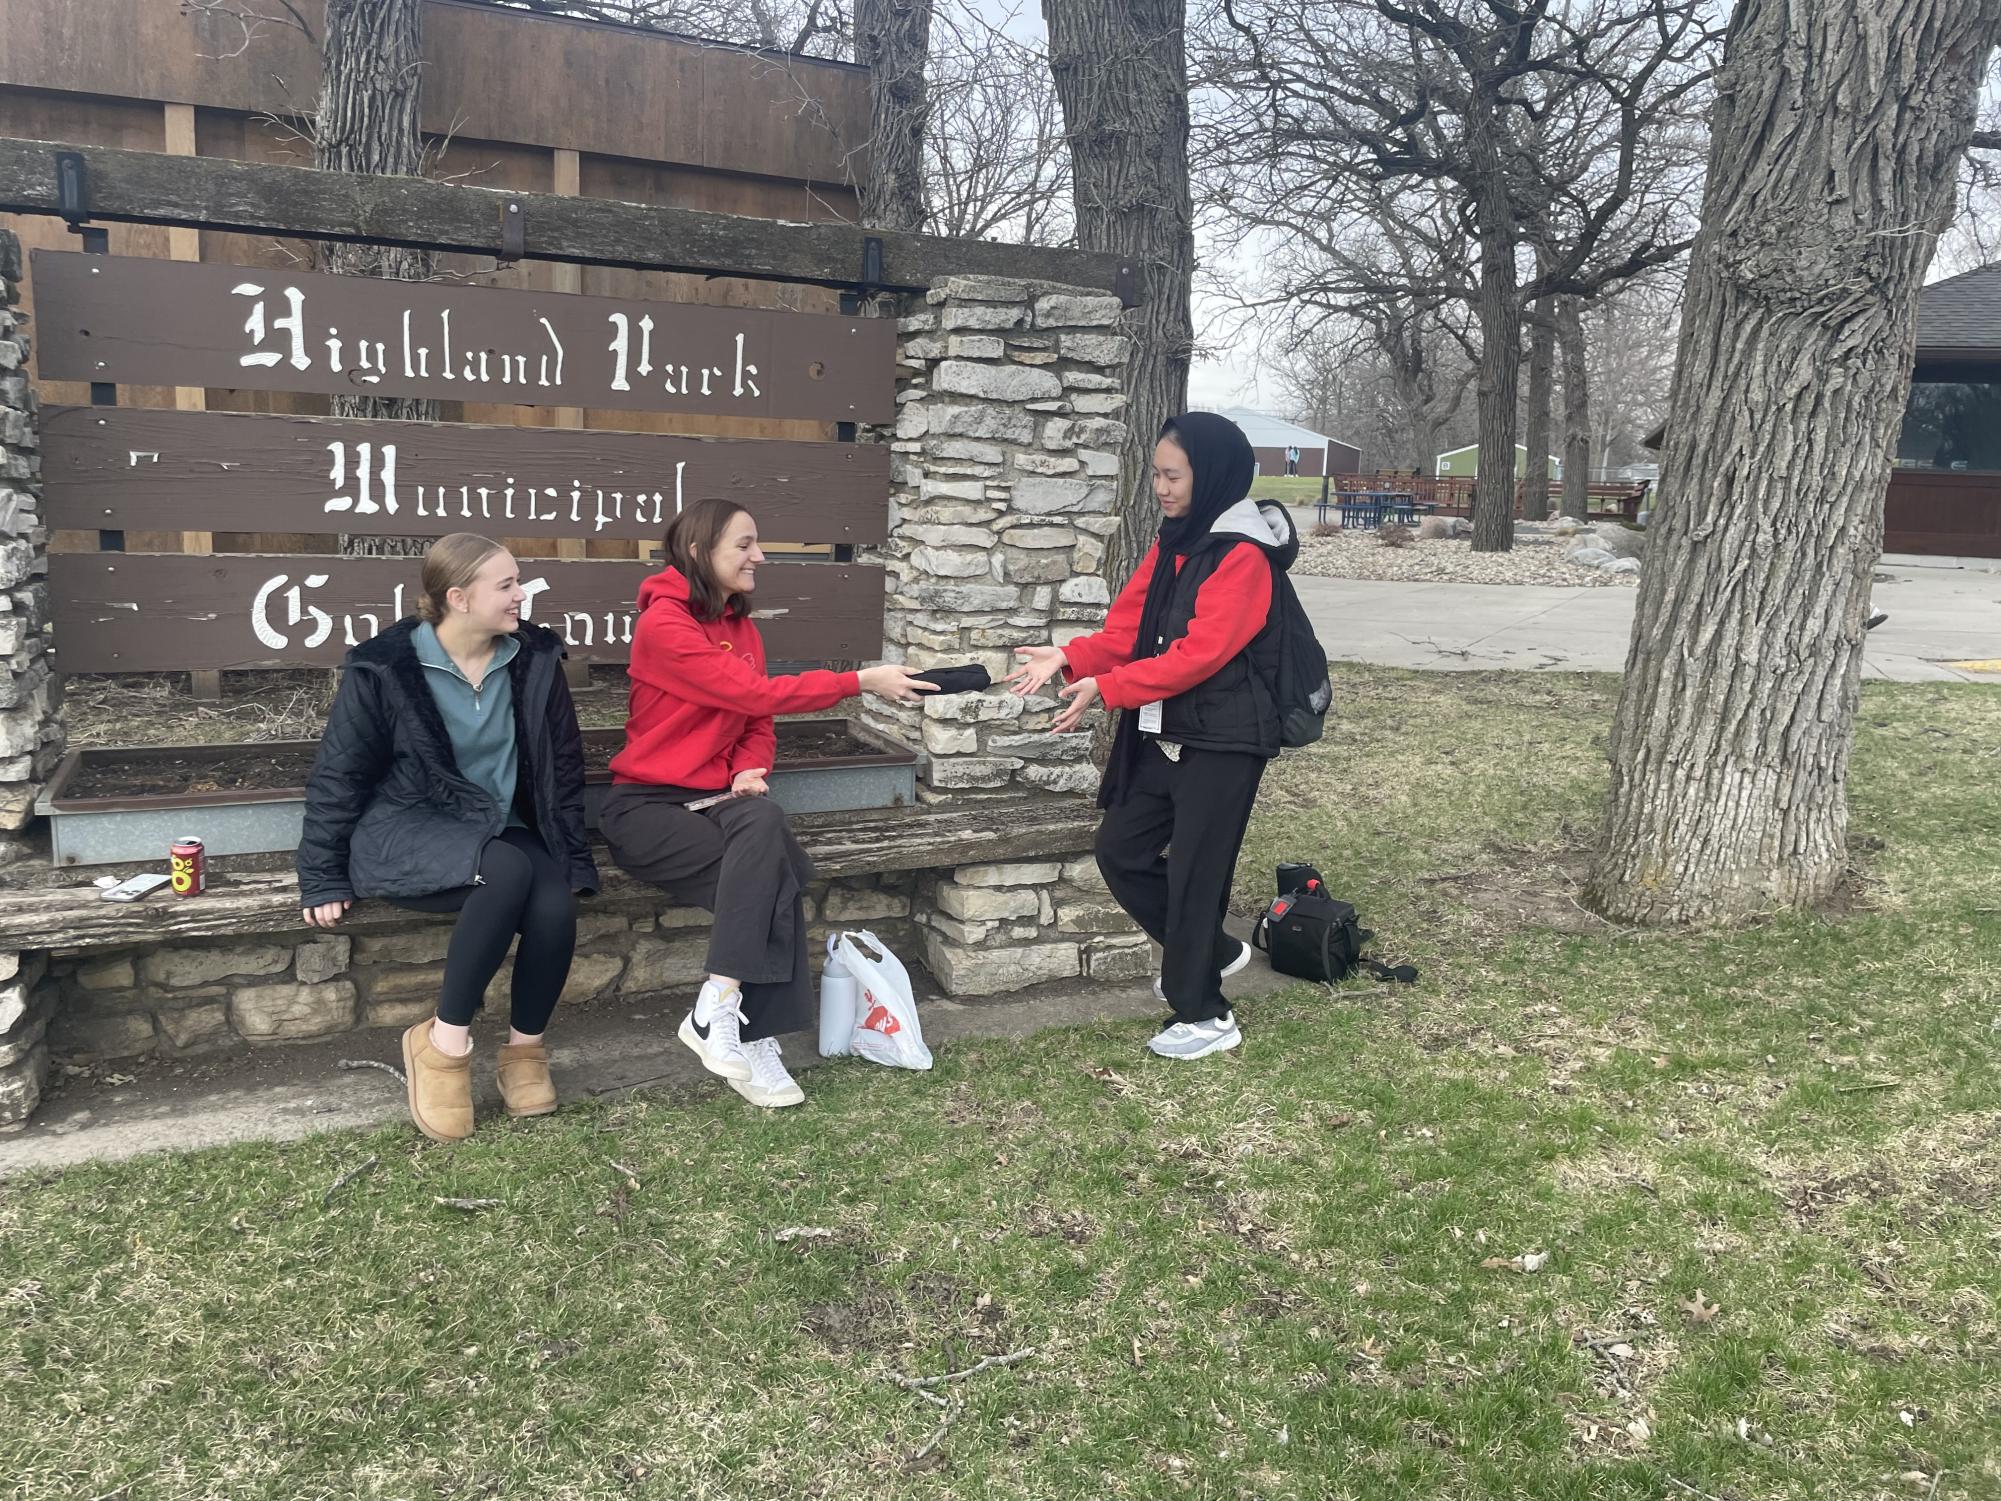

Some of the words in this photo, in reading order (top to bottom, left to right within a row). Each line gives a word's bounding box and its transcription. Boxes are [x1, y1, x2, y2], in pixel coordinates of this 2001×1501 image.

[231, 282, 564, 387] Highland
[607, 312, 761, 398] Park
[324, 441, 686, 532] Municipal
[250, 574, 405, 651] Gol
